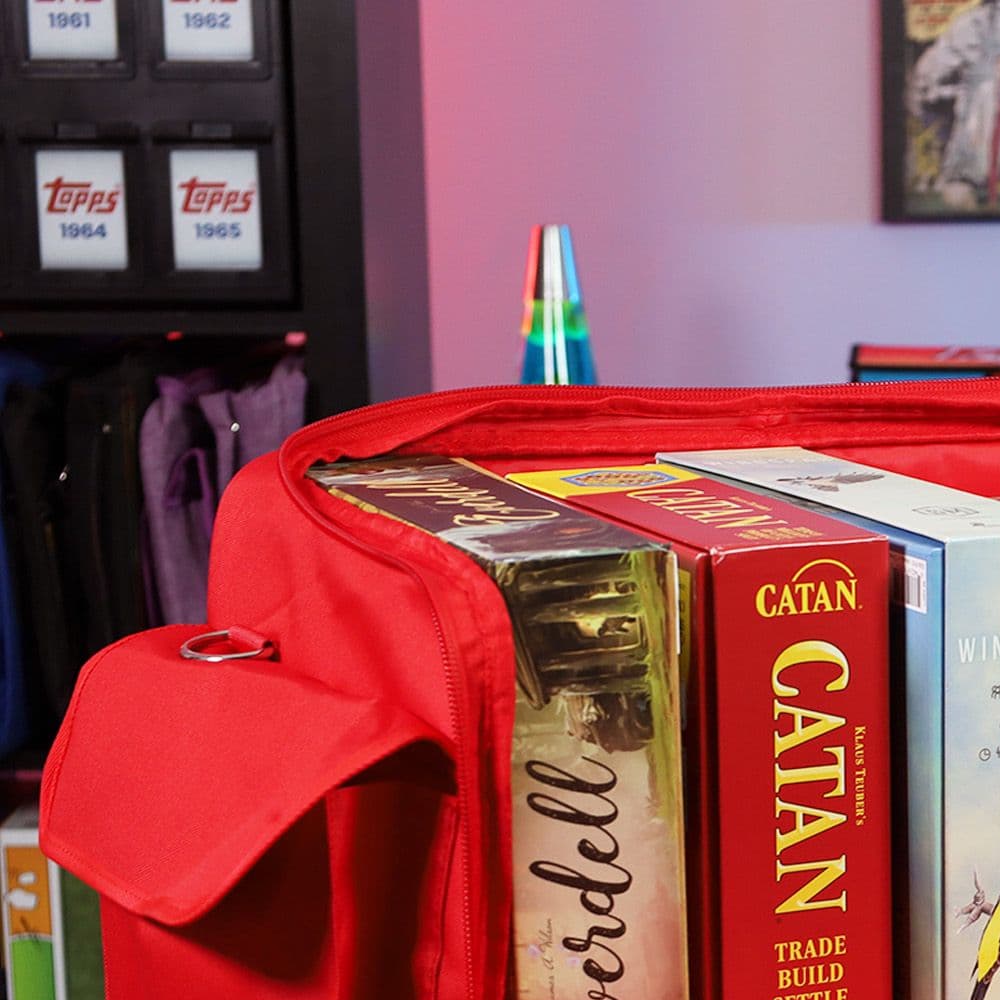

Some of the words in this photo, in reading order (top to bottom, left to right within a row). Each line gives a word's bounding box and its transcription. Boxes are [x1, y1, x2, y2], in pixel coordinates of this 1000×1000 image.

[48, 12, 91, 30] 1961
[184, 12, 232, 30] 1962
[60, 223, 107, 240] 1964
[194, 223, 242, 240] 1965
[626, 486, 789, 529] CATAN
[756, 576, 858, 618] CATAN
[854, 726, 867, 766] KLAUS
[771, 639, 851, 916] CATAN
[774, 934, 847, 963] TRADE
[777, 962, 844, 990] BUILD
